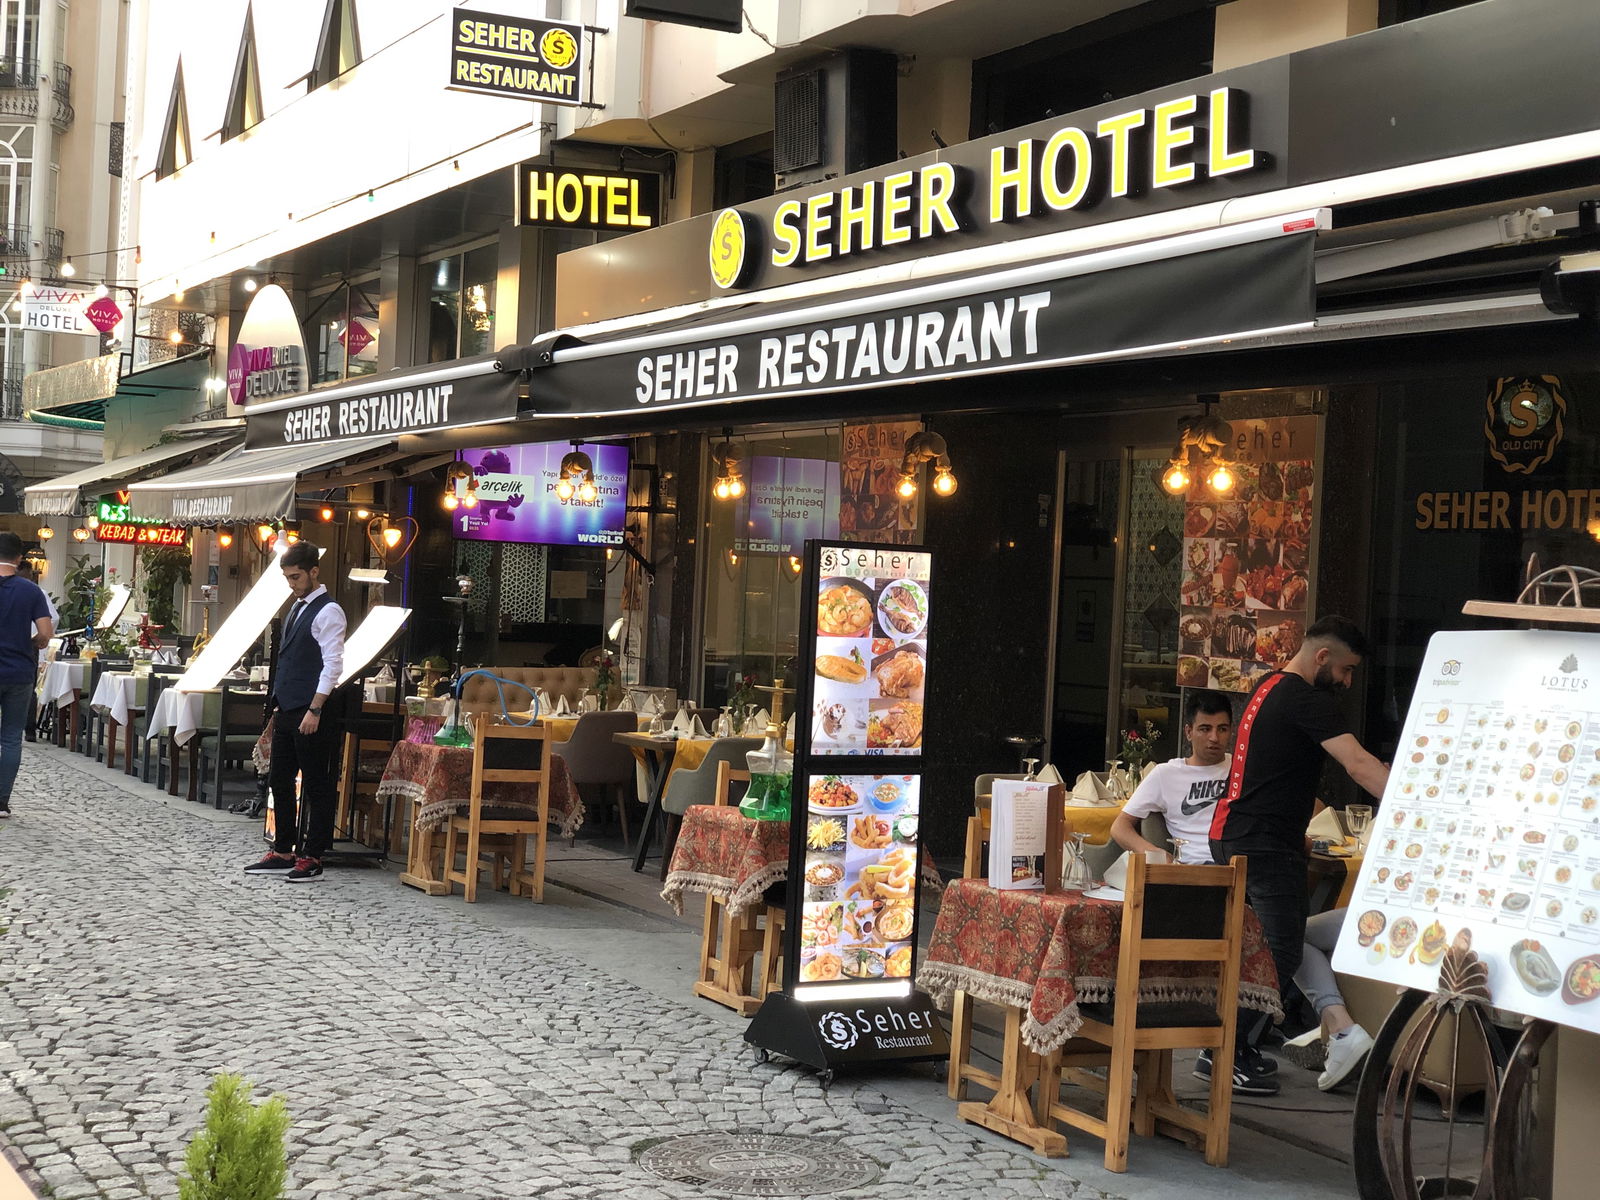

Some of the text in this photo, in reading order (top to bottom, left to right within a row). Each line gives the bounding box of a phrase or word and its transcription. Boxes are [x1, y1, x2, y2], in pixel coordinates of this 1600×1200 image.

[458, 19, 537, 53] SEHER
[552, 40, 565, 55] S
[456, 59, 576, 95] RESTAURANT
[771, 86, 1256, 268] SEHER HOTEL
[528, 170, 653, 227] HOTEL
[33, 289, 80, 304] VIVA
[28, 312, 83, 331] HOTEL
[90, 308, 120, 320] VIVA
[635, 290, 1051, 404] SEHER RESTAURANT
[246, 346, 272, 370] VIVA
[228, 368, 243, 380] VIVA
[246, 368, 293, 397] DELUXE
[284, 384, 454, 443] SEHER RESTAURANT
[1508, 391, 1539, 437] S
[857, 425, 907, 449] Seher
[1237, 425, 1297, 451] eher
[1502, 439, 1545, 451] OLD CITY
[481, 480, 523, 494] arçelik
[172, 498, 188, 516] VIVA
[188, 495, 233, 516] RESTAURANT
[1415, 491, 1512, 530] SEHER
[460, 514, 469, 532] 1
[100, 525, 185, 544] KEBAB & TEAK
[577, 534, 624, 545] WORLD
[841, 549, 914, 569] Seher
[1541, 676, 1588, 689] LOTUS
[1188, 779, 1228, 801] NIKE
[856, 1007, 935, 1034] Seher
[874, 1034, 933, 1050] Restaurant
